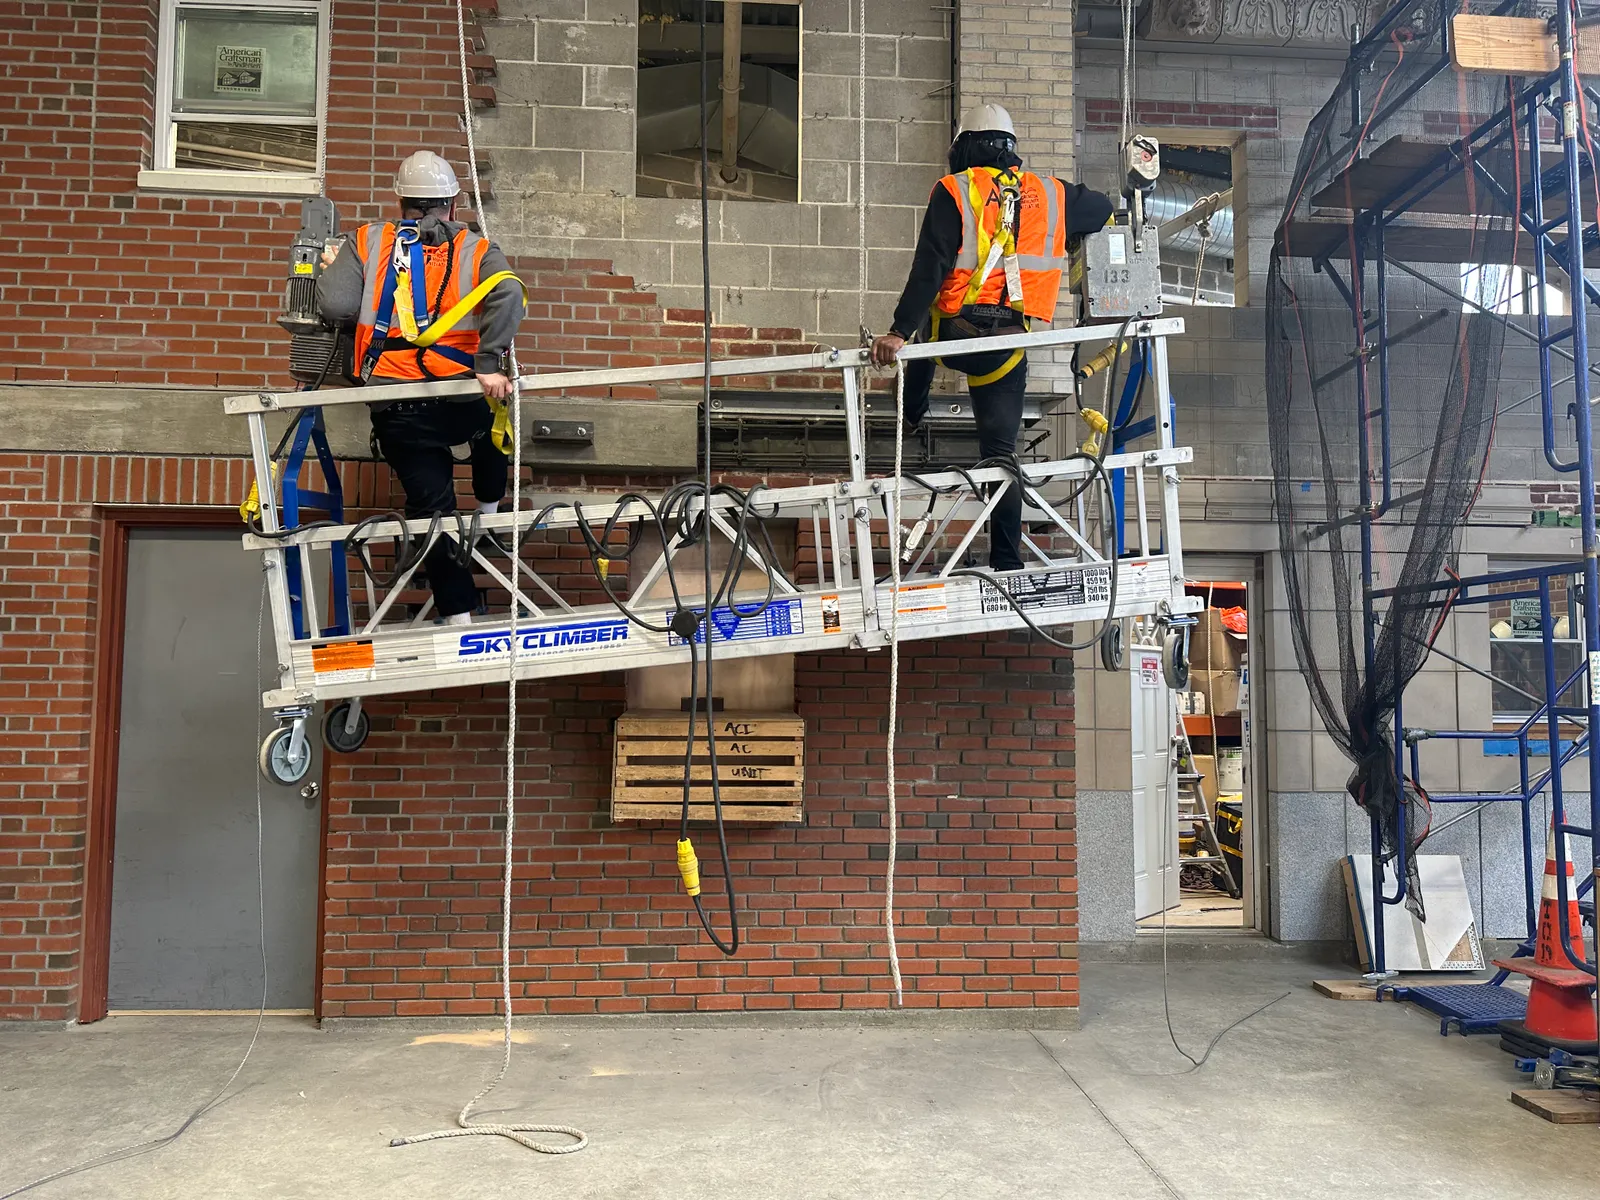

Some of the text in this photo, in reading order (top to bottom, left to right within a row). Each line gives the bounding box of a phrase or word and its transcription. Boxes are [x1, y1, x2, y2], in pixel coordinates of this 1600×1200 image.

[220, 47, 261, 56] American
[220, 54, 261, 63] Craftsman
[1104, 269, 1130, 283] 133
[1084, 569, 1098, 577] 1000
[1088, 594, 1108, 602] 340 kg
[986, 604, 998, 612] 680
[731, 766, 772, 779] UNIT
